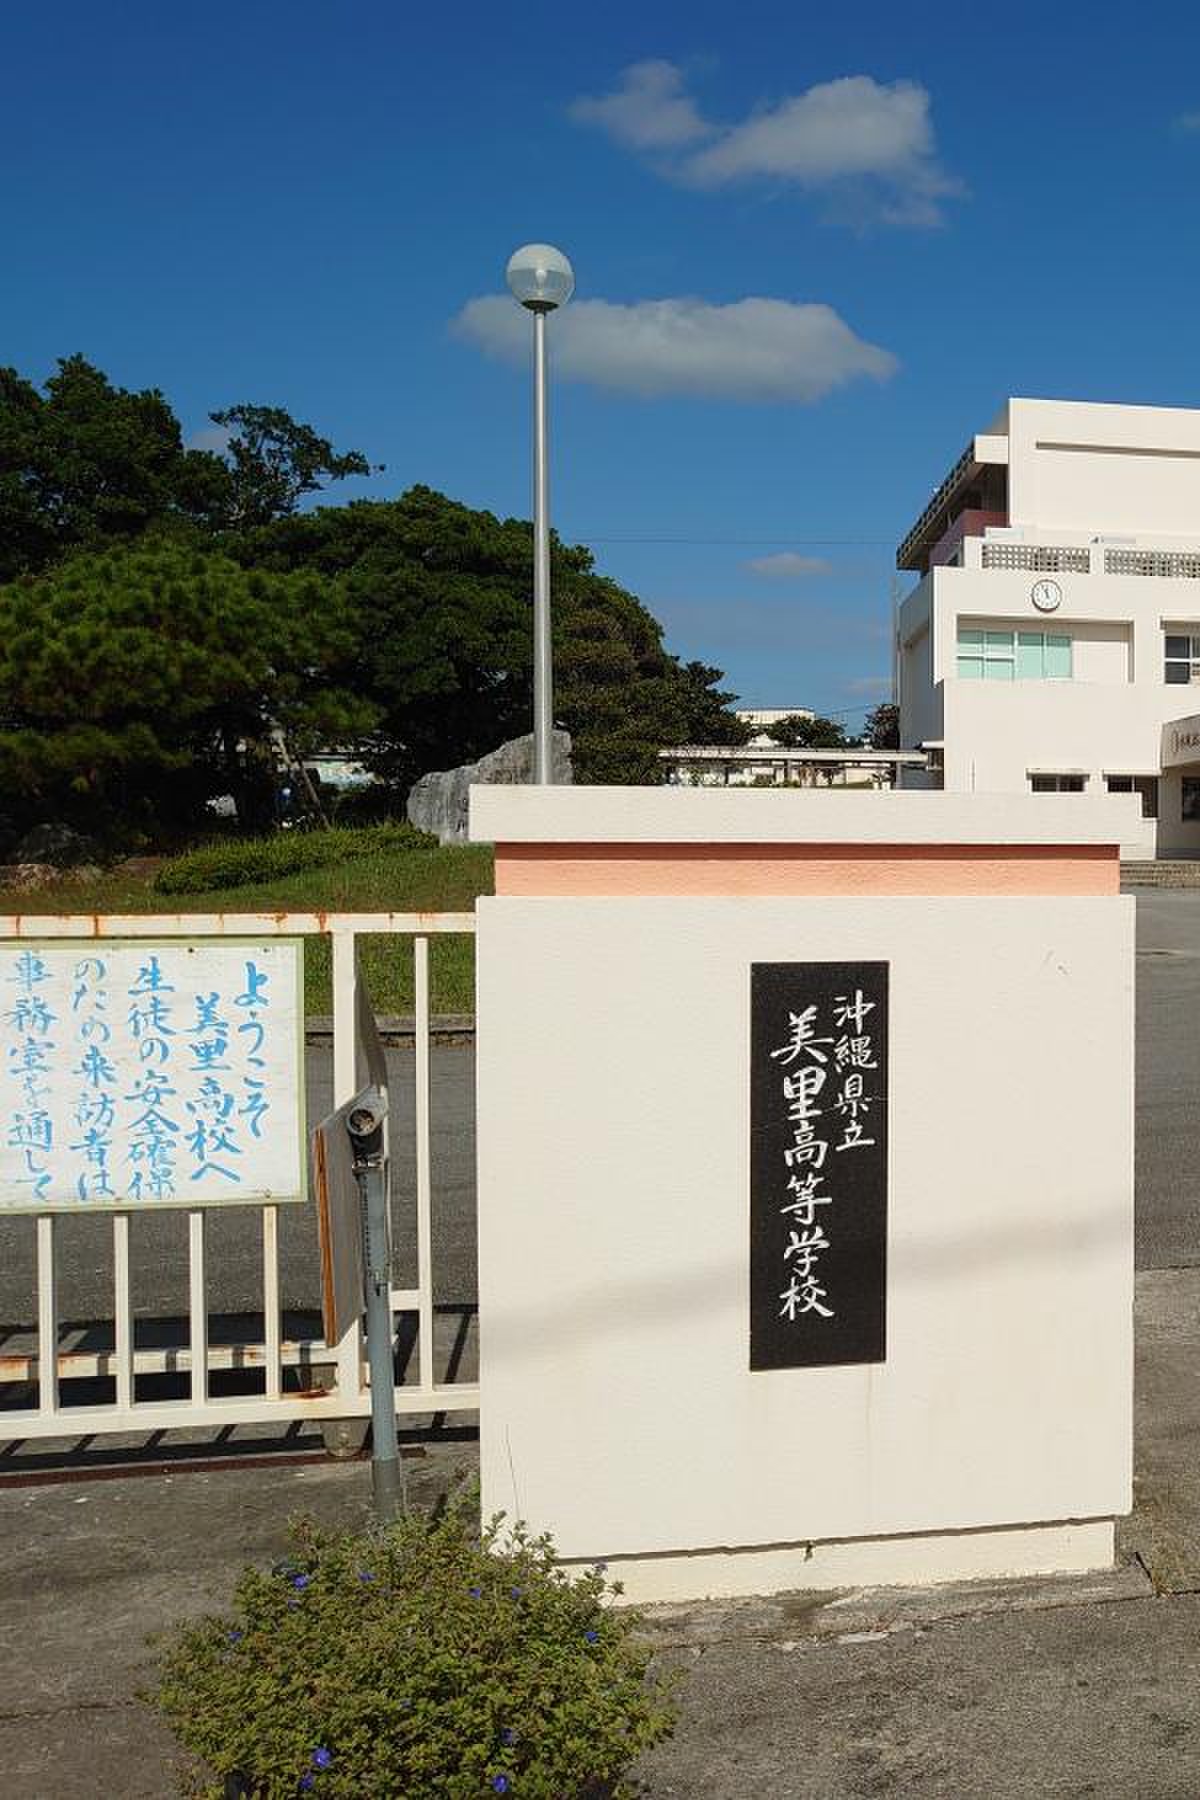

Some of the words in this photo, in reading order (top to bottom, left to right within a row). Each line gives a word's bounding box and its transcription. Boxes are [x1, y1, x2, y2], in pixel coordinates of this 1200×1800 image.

[125, 956, 180, 1200] 生徒の安全確保
[185, 991, 242, 1182] 美里高校へ
[234, 960, 270, 1138] ようこそ
[832, 990, 878, 1152] 沖縄県立
[770, 1005, 834, 1321] 美里高等学校
